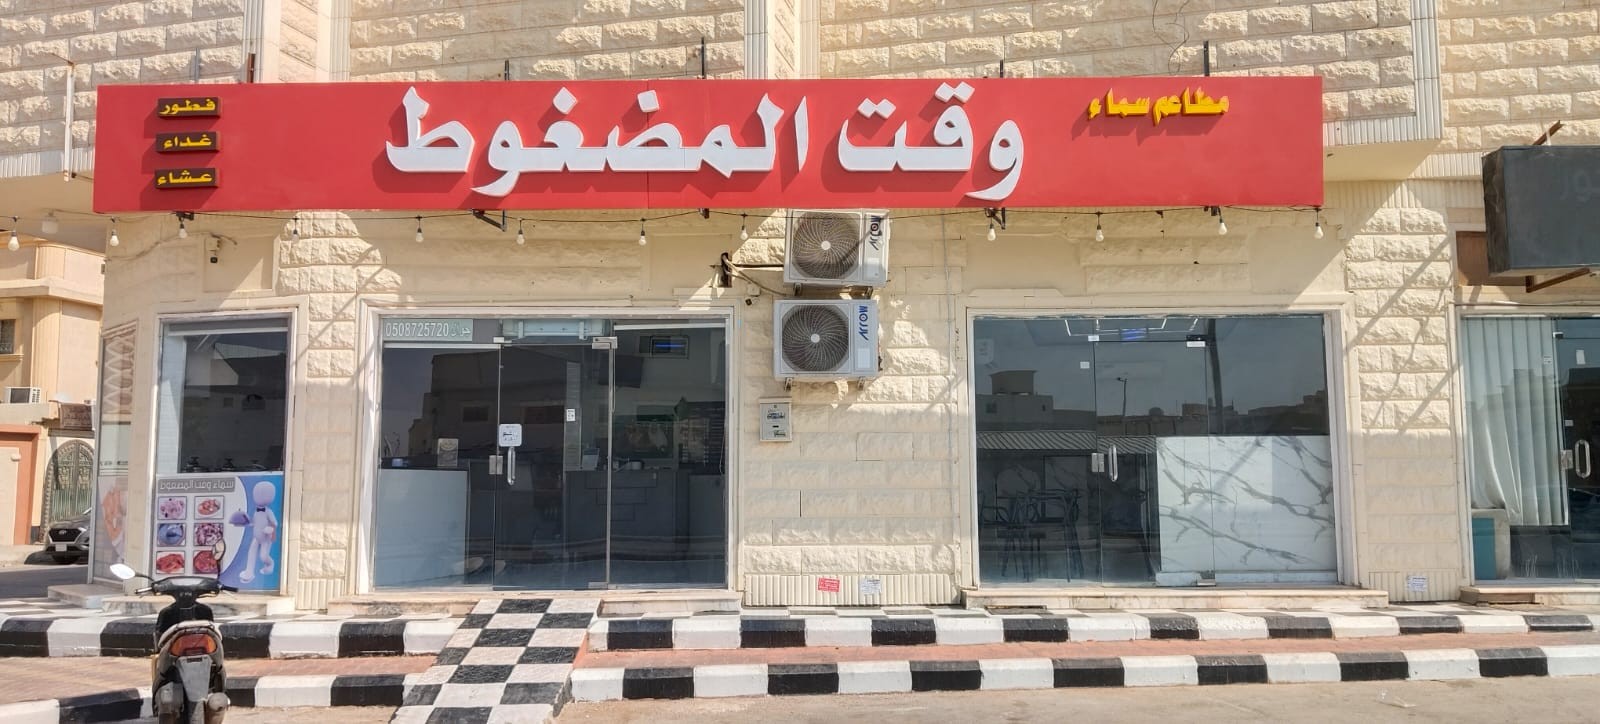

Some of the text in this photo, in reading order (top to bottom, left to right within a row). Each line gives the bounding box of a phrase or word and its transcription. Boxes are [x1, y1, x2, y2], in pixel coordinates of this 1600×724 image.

[159, 98, 216, 115] فطور
[1088, 86, 1230, 126] مطاعم سماء
[163, 134, 212, 149] غداء
[385, 81, 1024, 201] وقت المضغوط
[157, 170, 213, 186] عشاء
[385, 322, 450, 337] 0508725720
